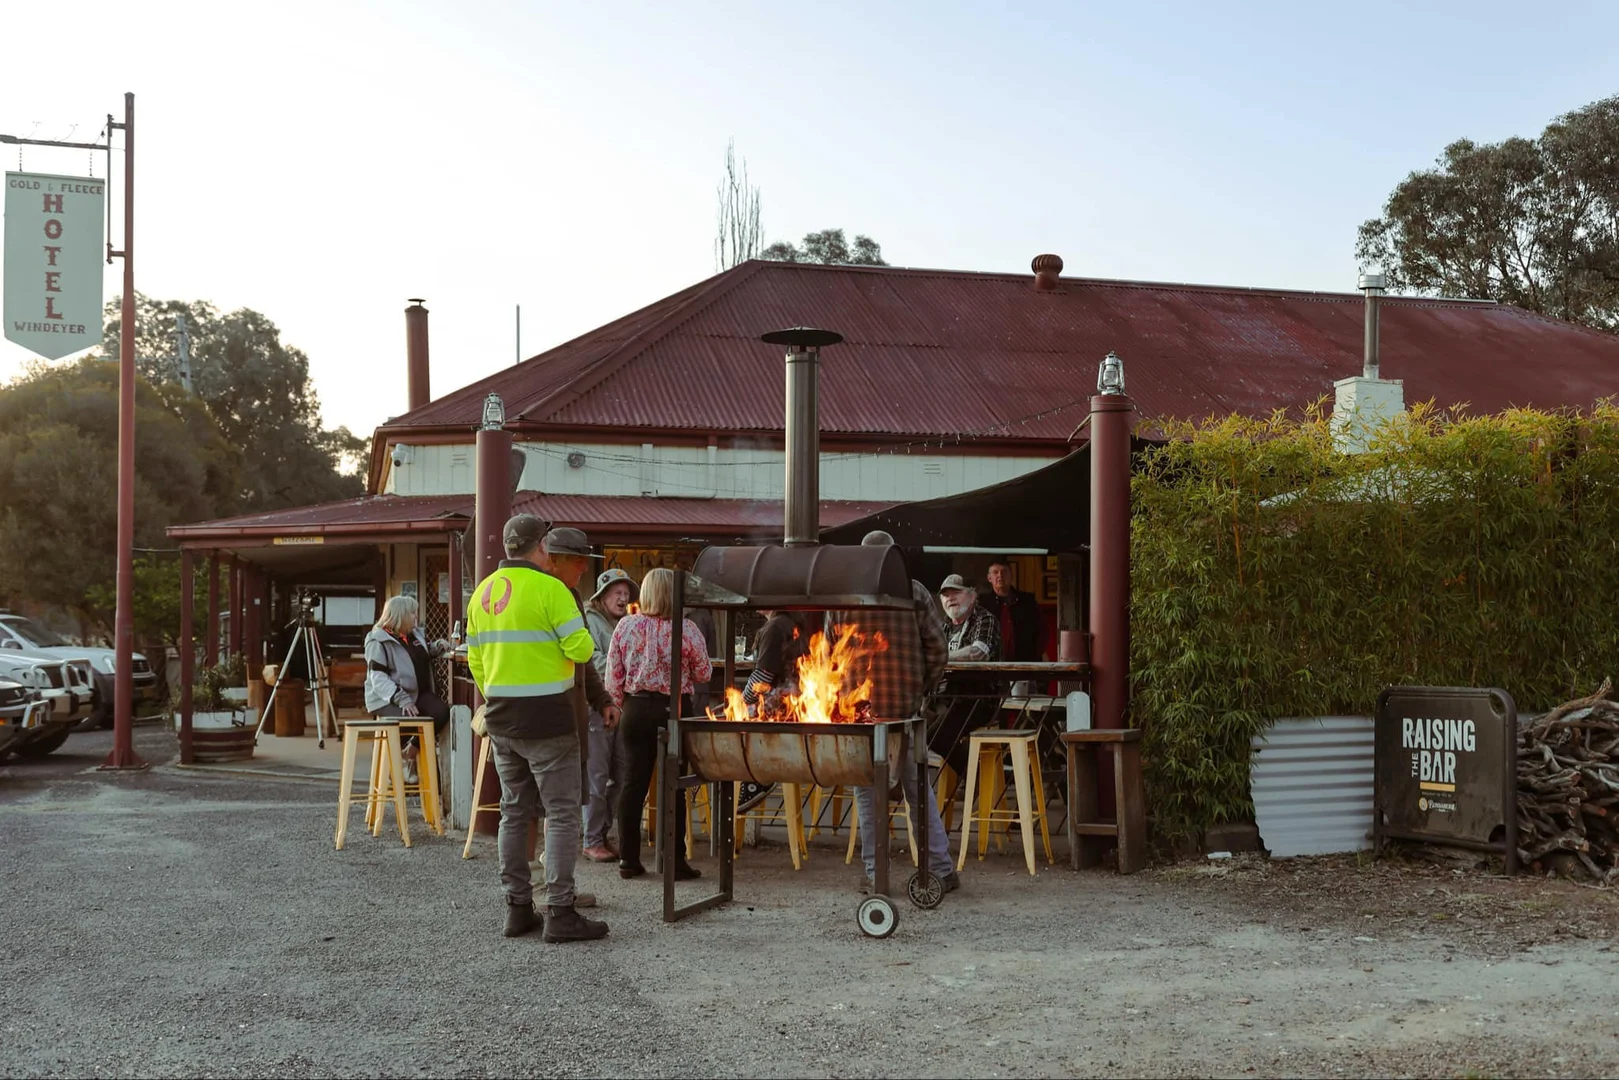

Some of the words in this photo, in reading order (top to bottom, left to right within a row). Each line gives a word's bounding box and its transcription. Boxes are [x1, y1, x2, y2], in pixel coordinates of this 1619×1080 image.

[9, 180, 40, 190] GOLD
[60, 183, 103, 195] FLEECE
[42, 193, 64, 320] HOTEL
[14, 321, 86, 335] WINDEYER
[1402, 718, 1476, 752] RAISING
[1411, 752, 1419, 778] THE
[1420, 750, 1456, 783] BAR
